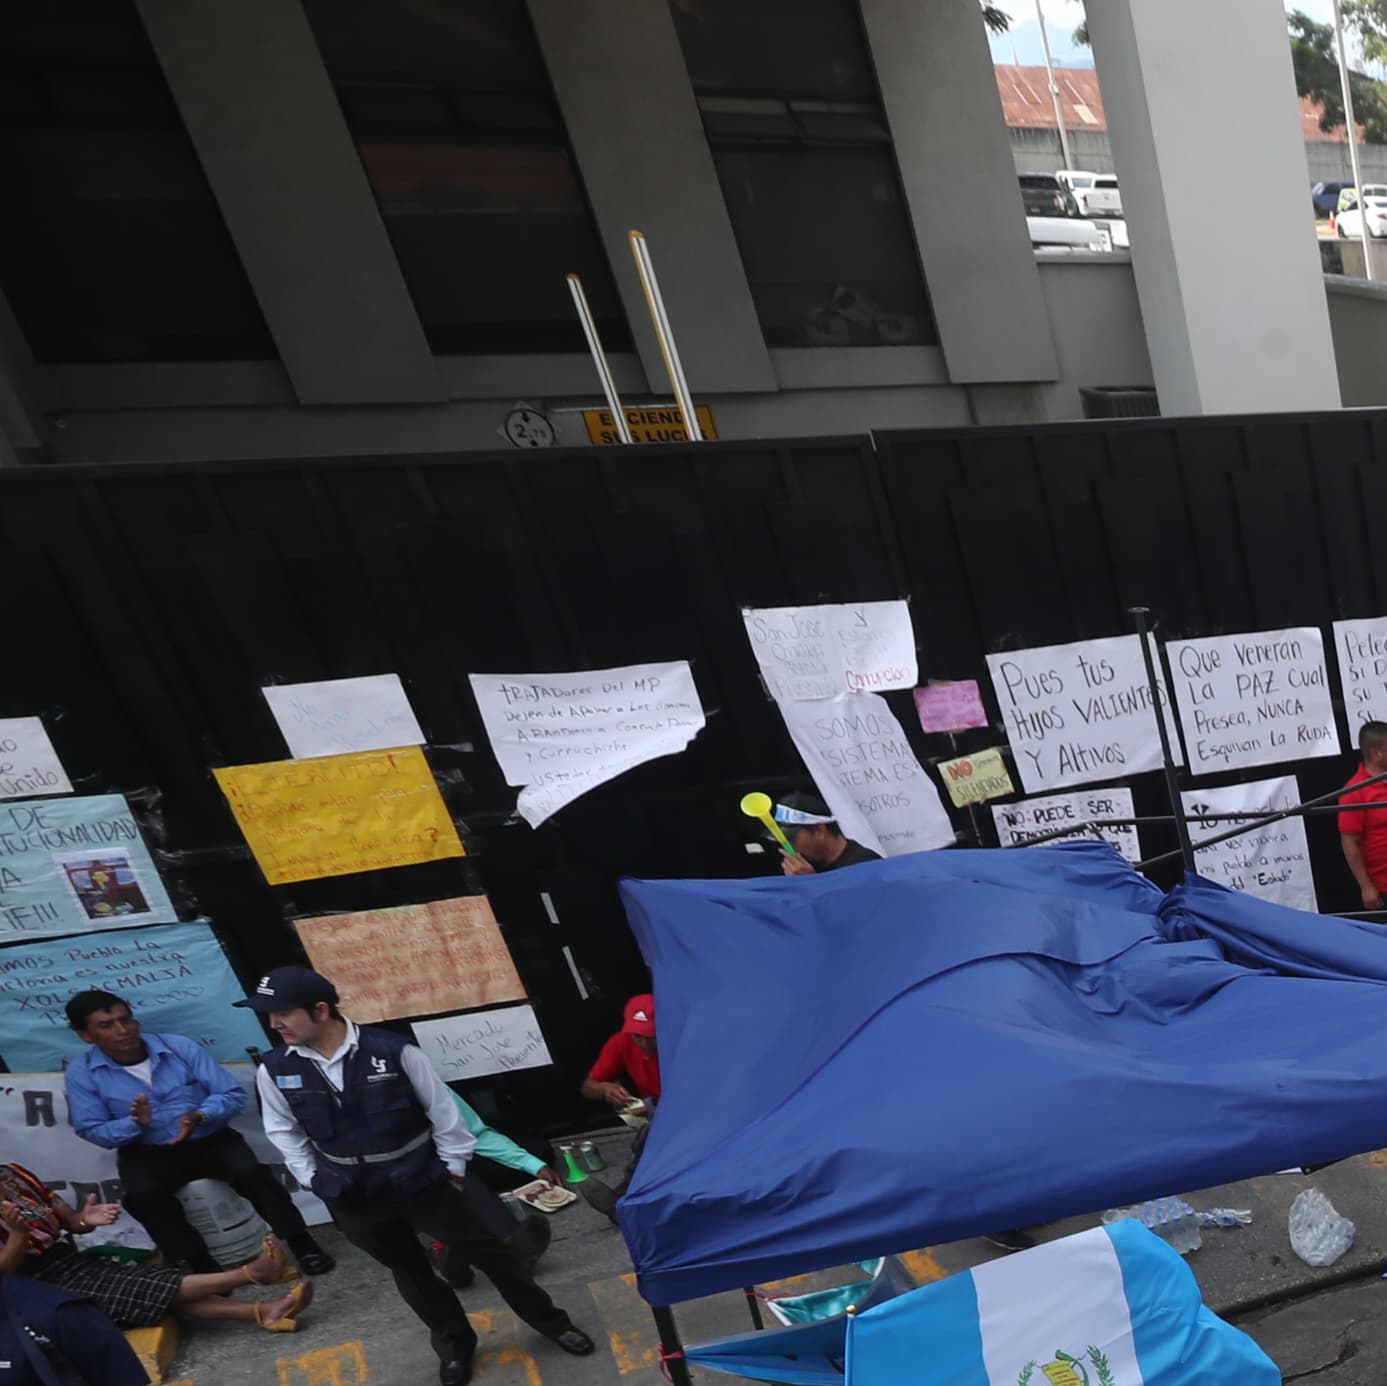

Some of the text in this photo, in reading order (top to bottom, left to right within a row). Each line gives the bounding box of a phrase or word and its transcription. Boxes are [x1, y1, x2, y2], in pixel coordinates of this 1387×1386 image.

[600, 410, 699, 427] ECIEND
[1179, 645, 1221, 678] Que
[1000, 655, 1115, 706] Pues tus
[1236, 670, 1280, 699] PAZ
[1257, 698, 1304, 723] NUNCA
[1025, 747, 1045, 779] Y
[8, 805, 51, 831] DE
[1002, 799, 1114, 827] NO PUEDE SER
